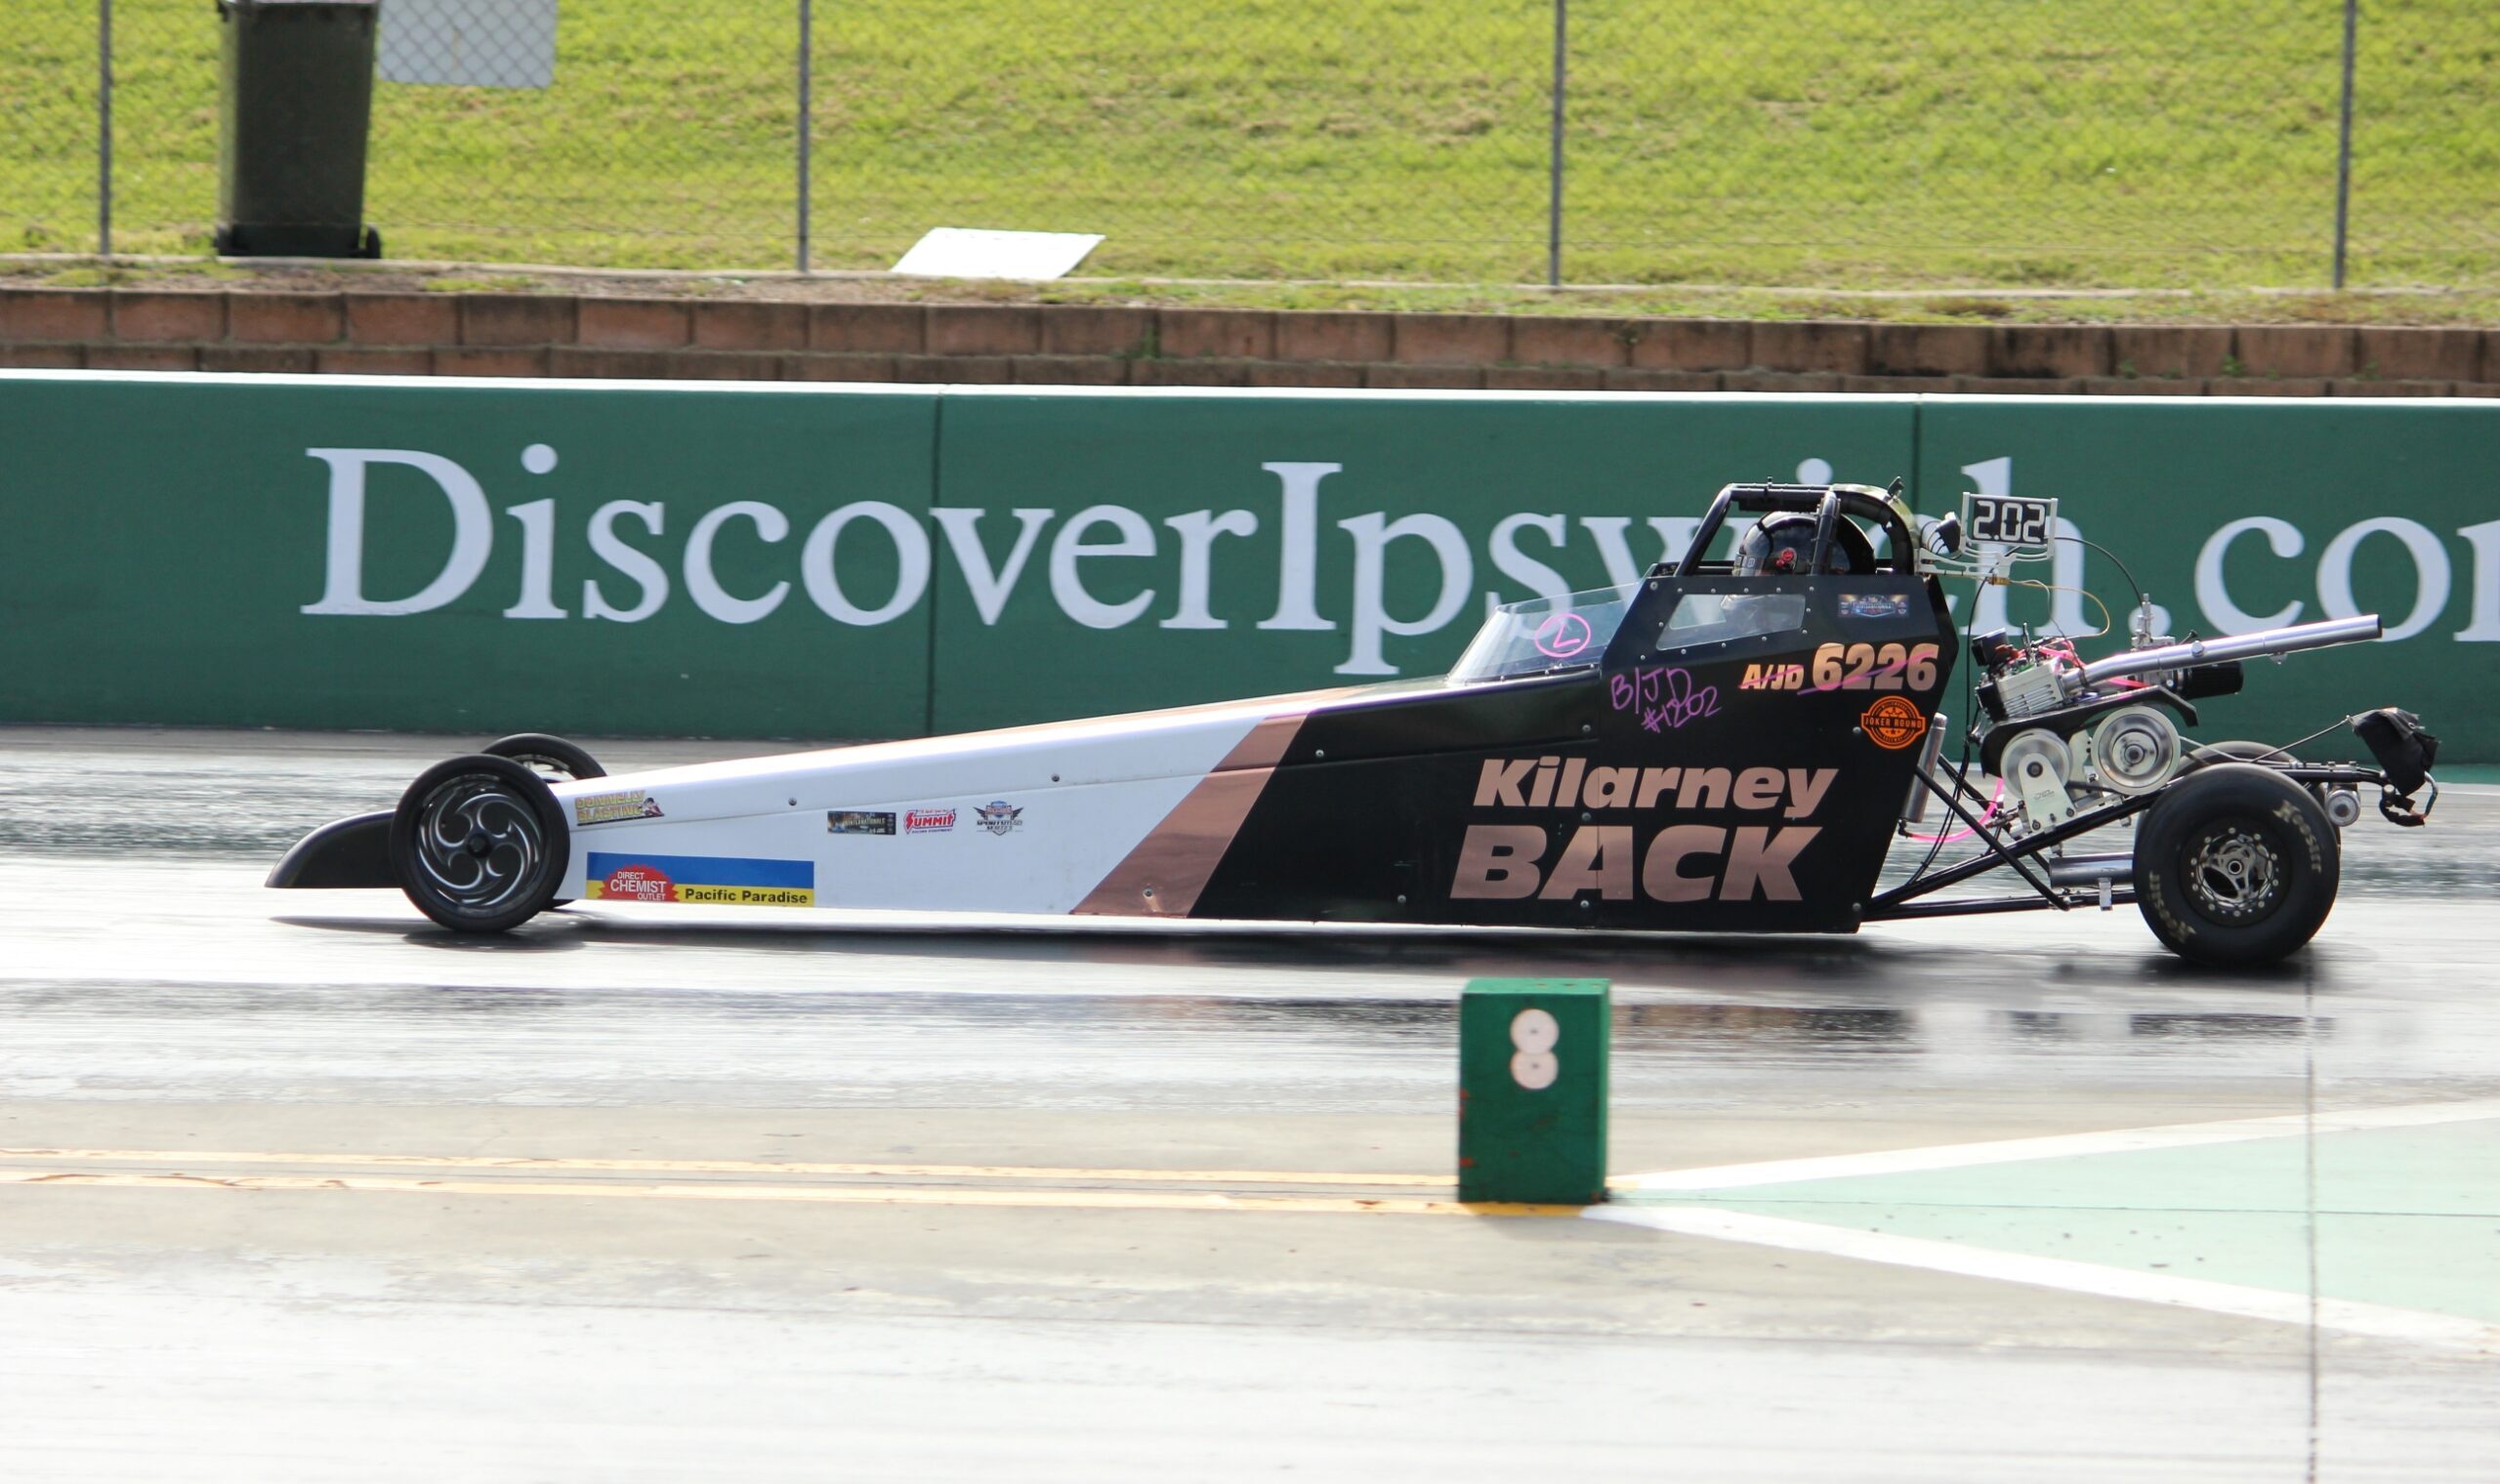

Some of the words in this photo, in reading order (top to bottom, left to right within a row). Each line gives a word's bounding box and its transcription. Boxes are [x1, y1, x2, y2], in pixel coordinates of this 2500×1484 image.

[1738, 663, 1805, 690] A/JD
[1812, 642, 1939, 692] 6226
[1610, 666, 1691, 715] B/JD
[1864, 717, 1891, 727] JOKER
[1894, 719, 1922, 729] ROUND
[1473, 756, 1840, 818] Kilarney
[617, 871, 645, 881] DIRECT
[1449, 824, 1823, 903] BACK
[609, 879, 667, 894] CHEMIST
[637, 892, 666, 902] OUTLET
[685, 887, 736, 902] Pacific
[741, 889, 808, 904] Paradise
[1510, 1008, 1560, 1091] 8
